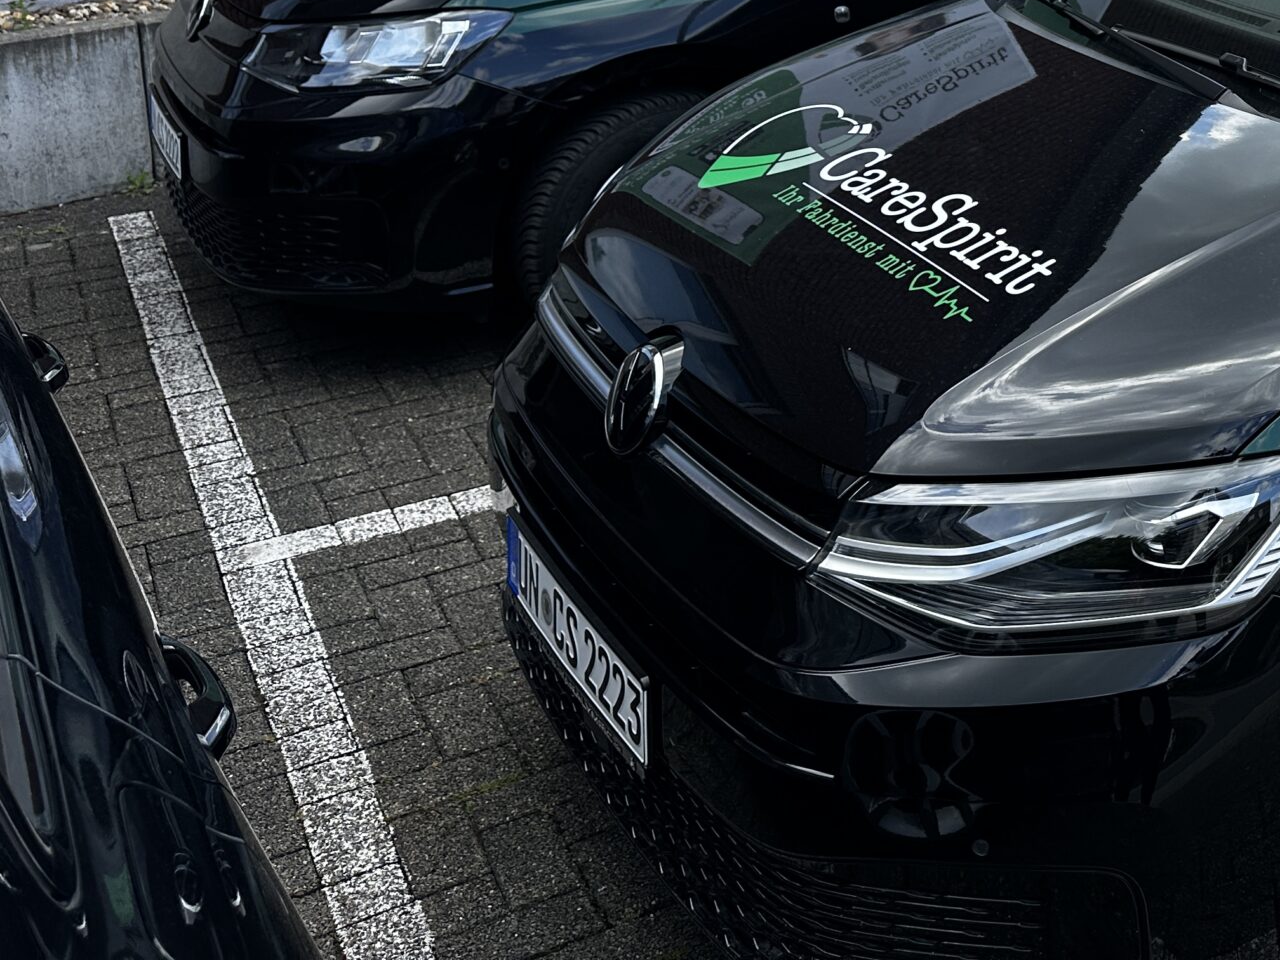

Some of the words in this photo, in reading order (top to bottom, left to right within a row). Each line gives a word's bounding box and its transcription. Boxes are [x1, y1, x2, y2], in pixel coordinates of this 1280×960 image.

[771, 183, 805, 213] Ihr
[800, 198, 887, 260] Fahrdienst
[874, 251, 915, 281] mit
[819, 146, 1057, 296] CareSpirit
[553, 587, 578, 671] CS
[583, 627, 642, 747] 2223
